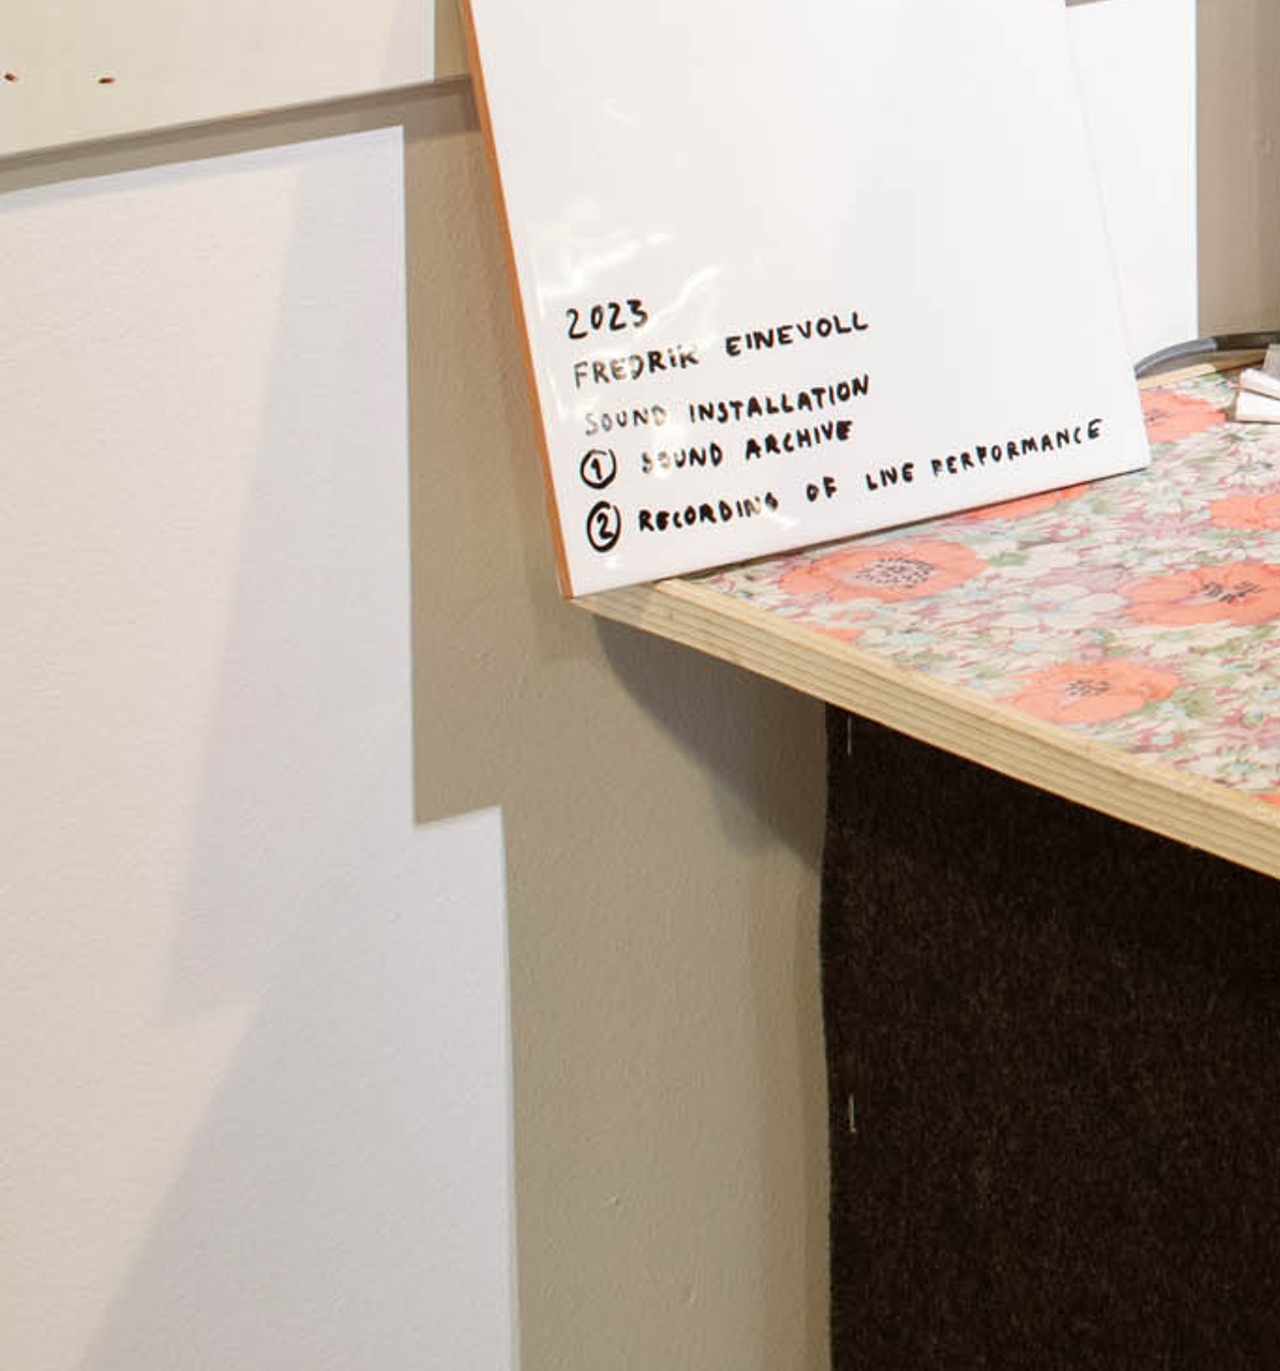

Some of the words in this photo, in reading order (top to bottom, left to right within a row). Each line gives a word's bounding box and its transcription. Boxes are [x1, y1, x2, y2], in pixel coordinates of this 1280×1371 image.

[565, 298, 649, 340] 2023
[725, 311, 869, 357] EINEVOLL
[585, 404, 668, 437] SOUND
[688, 373, 869, 424] INSTALLATION
[641, 442, 723, 475] SOUND
[745, 419, 853, 462] ARCHIVE
[637, 491, 779, 533] RECORDING
[805, 476, 837, 503] OF
[865, 461, 915, 492] LIVE
[930, 418, 1103, 477] PERFORMANCE
